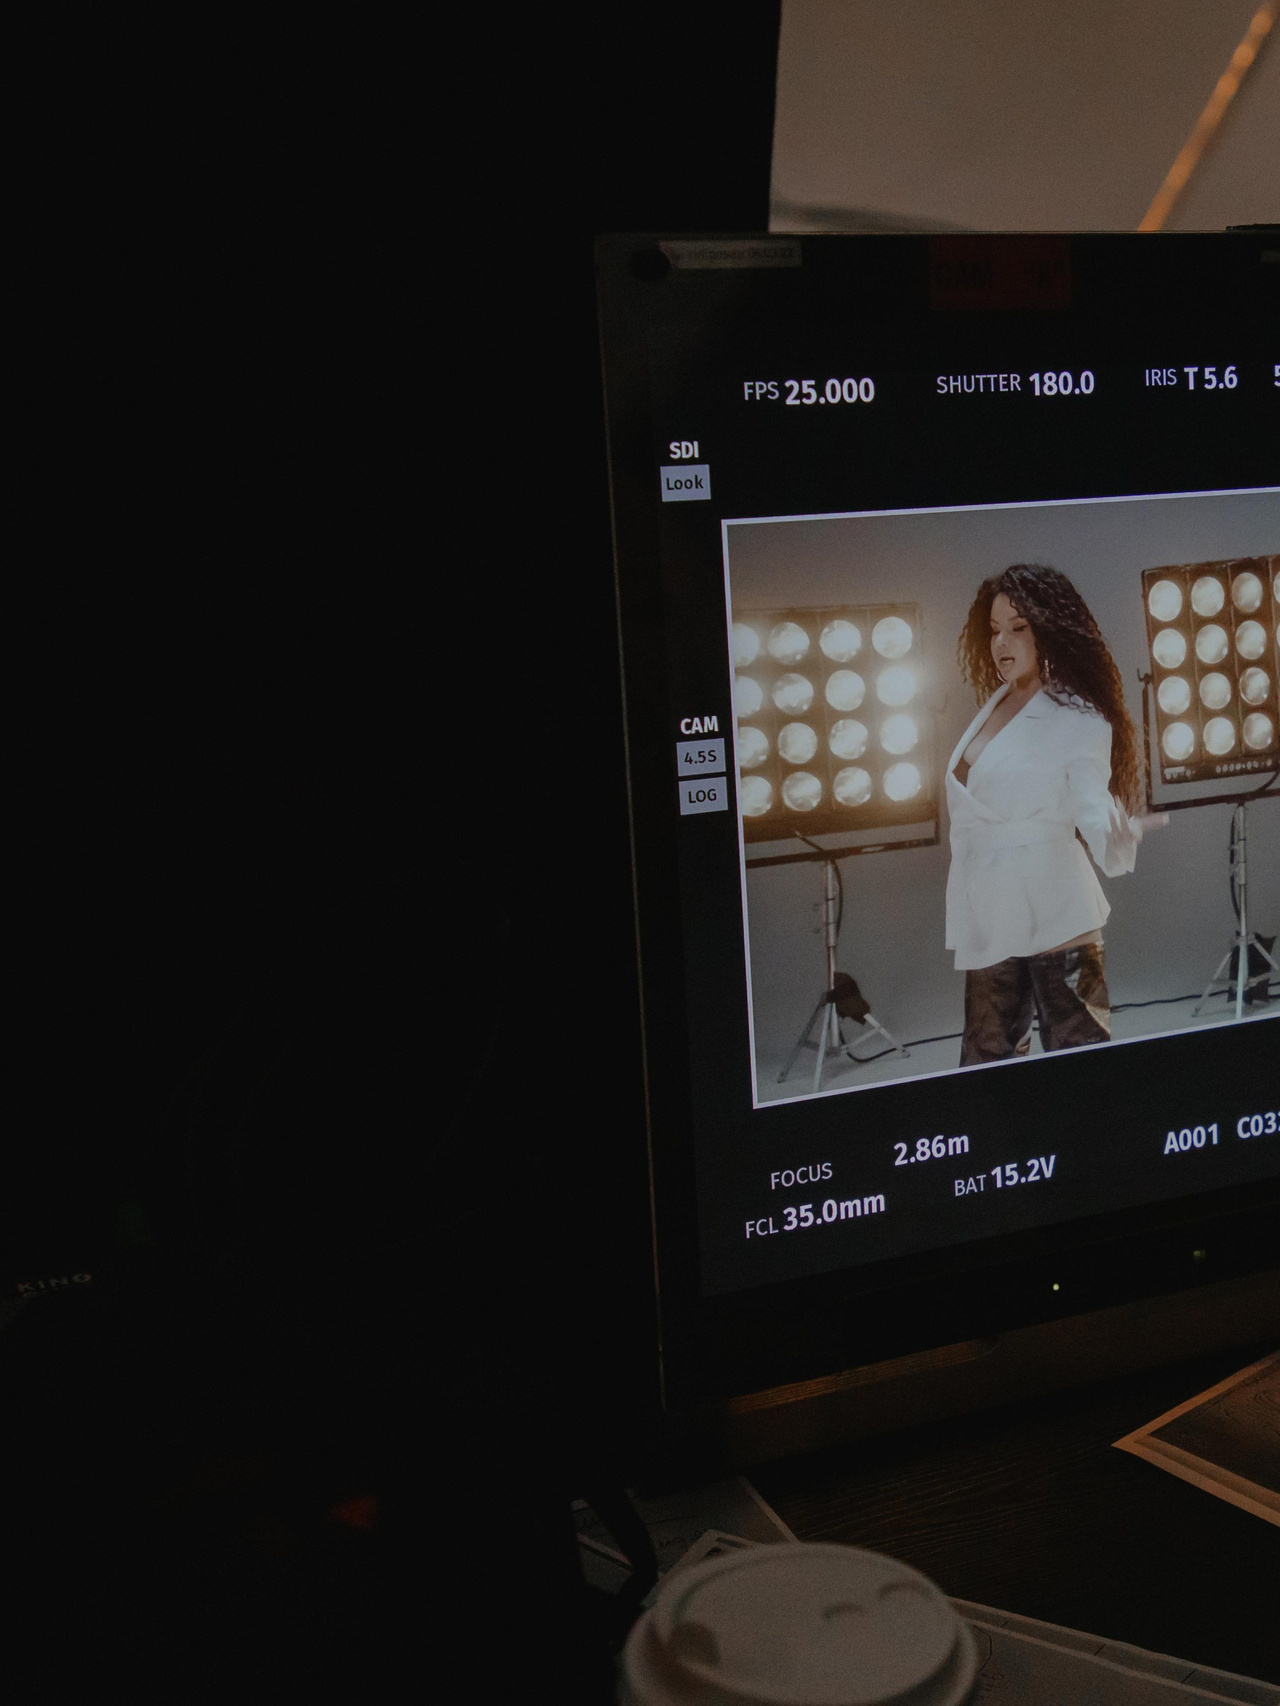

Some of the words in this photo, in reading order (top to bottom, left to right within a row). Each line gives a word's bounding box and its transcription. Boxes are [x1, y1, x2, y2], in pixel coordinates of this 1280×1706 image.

[937, 374, 1021, 393] SHUTTER
[1029, 370, 1094, 396] 180.0
[1146, 369, 1177, 386] IRIS
[744, 381, 779, 400] FPS
[785, 377, 875, 405] 25.000
[670, 441, 699, 459] SDI
[666, 475, 703, 490] Look
[680, 716, 718, 734] CAM
[684, 750, 716, 764] 4.5S
[688, 789, 716, 803] LOG
[1164, 1123, 1218, 1154] A001
[771, 1163, 832, 1189] FOCUS
[894, 1135, 969, 1166] 2.86m
[955, 1175, 986, 1196] BAT
[991, 1155, 1056, 1188] 15.2V
[746, 1217, 779, 1238] FCL
[783, 1194, 885, 1230] 35.0mm
